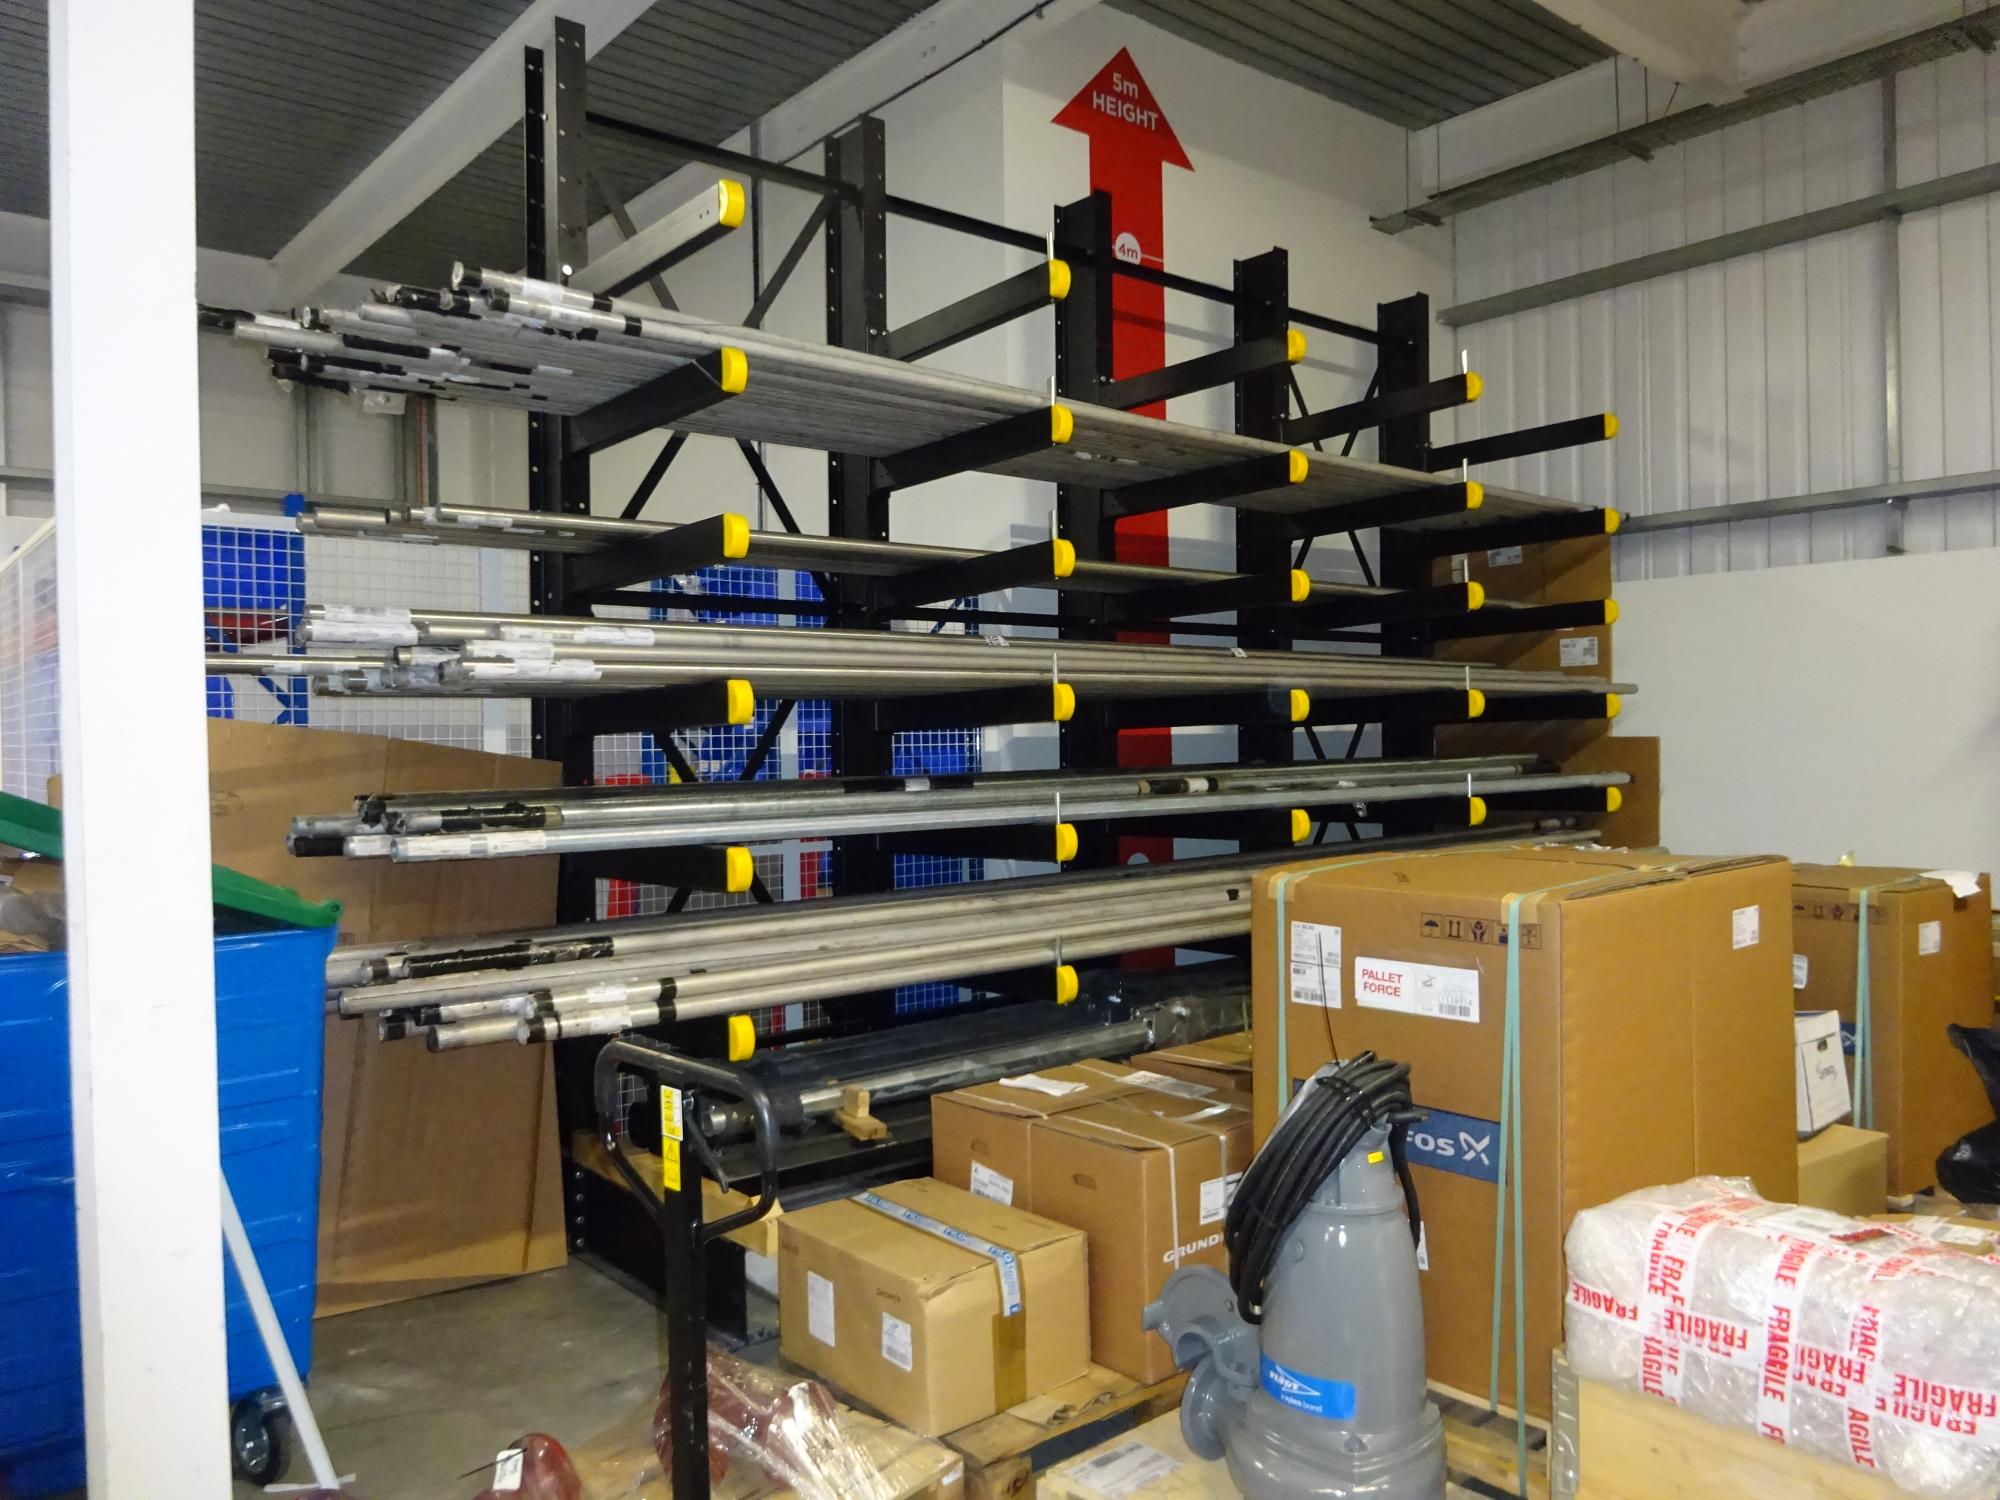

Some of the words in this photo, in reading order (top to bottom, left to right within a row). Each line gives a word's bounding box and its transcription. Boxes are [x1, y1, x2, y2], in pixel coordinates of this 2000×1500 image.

[1113, 72, 1138, 99] 5m
[1093, 91, 1158, 131] HEIGHT
[1118, 242, 1138, 260] 4m
[1362, 968, 1402, 984] PALLET
[1364, 981, 1400, 997] FORCE
[1163, 1232, 1224, 1263] GRUND
[1572, 1281, 1639, 1321] FRAGILE
[1663, 1308, 1748, 1351] FRAGILE
[1894, 1374, 1998, 1418] FRAGILE
